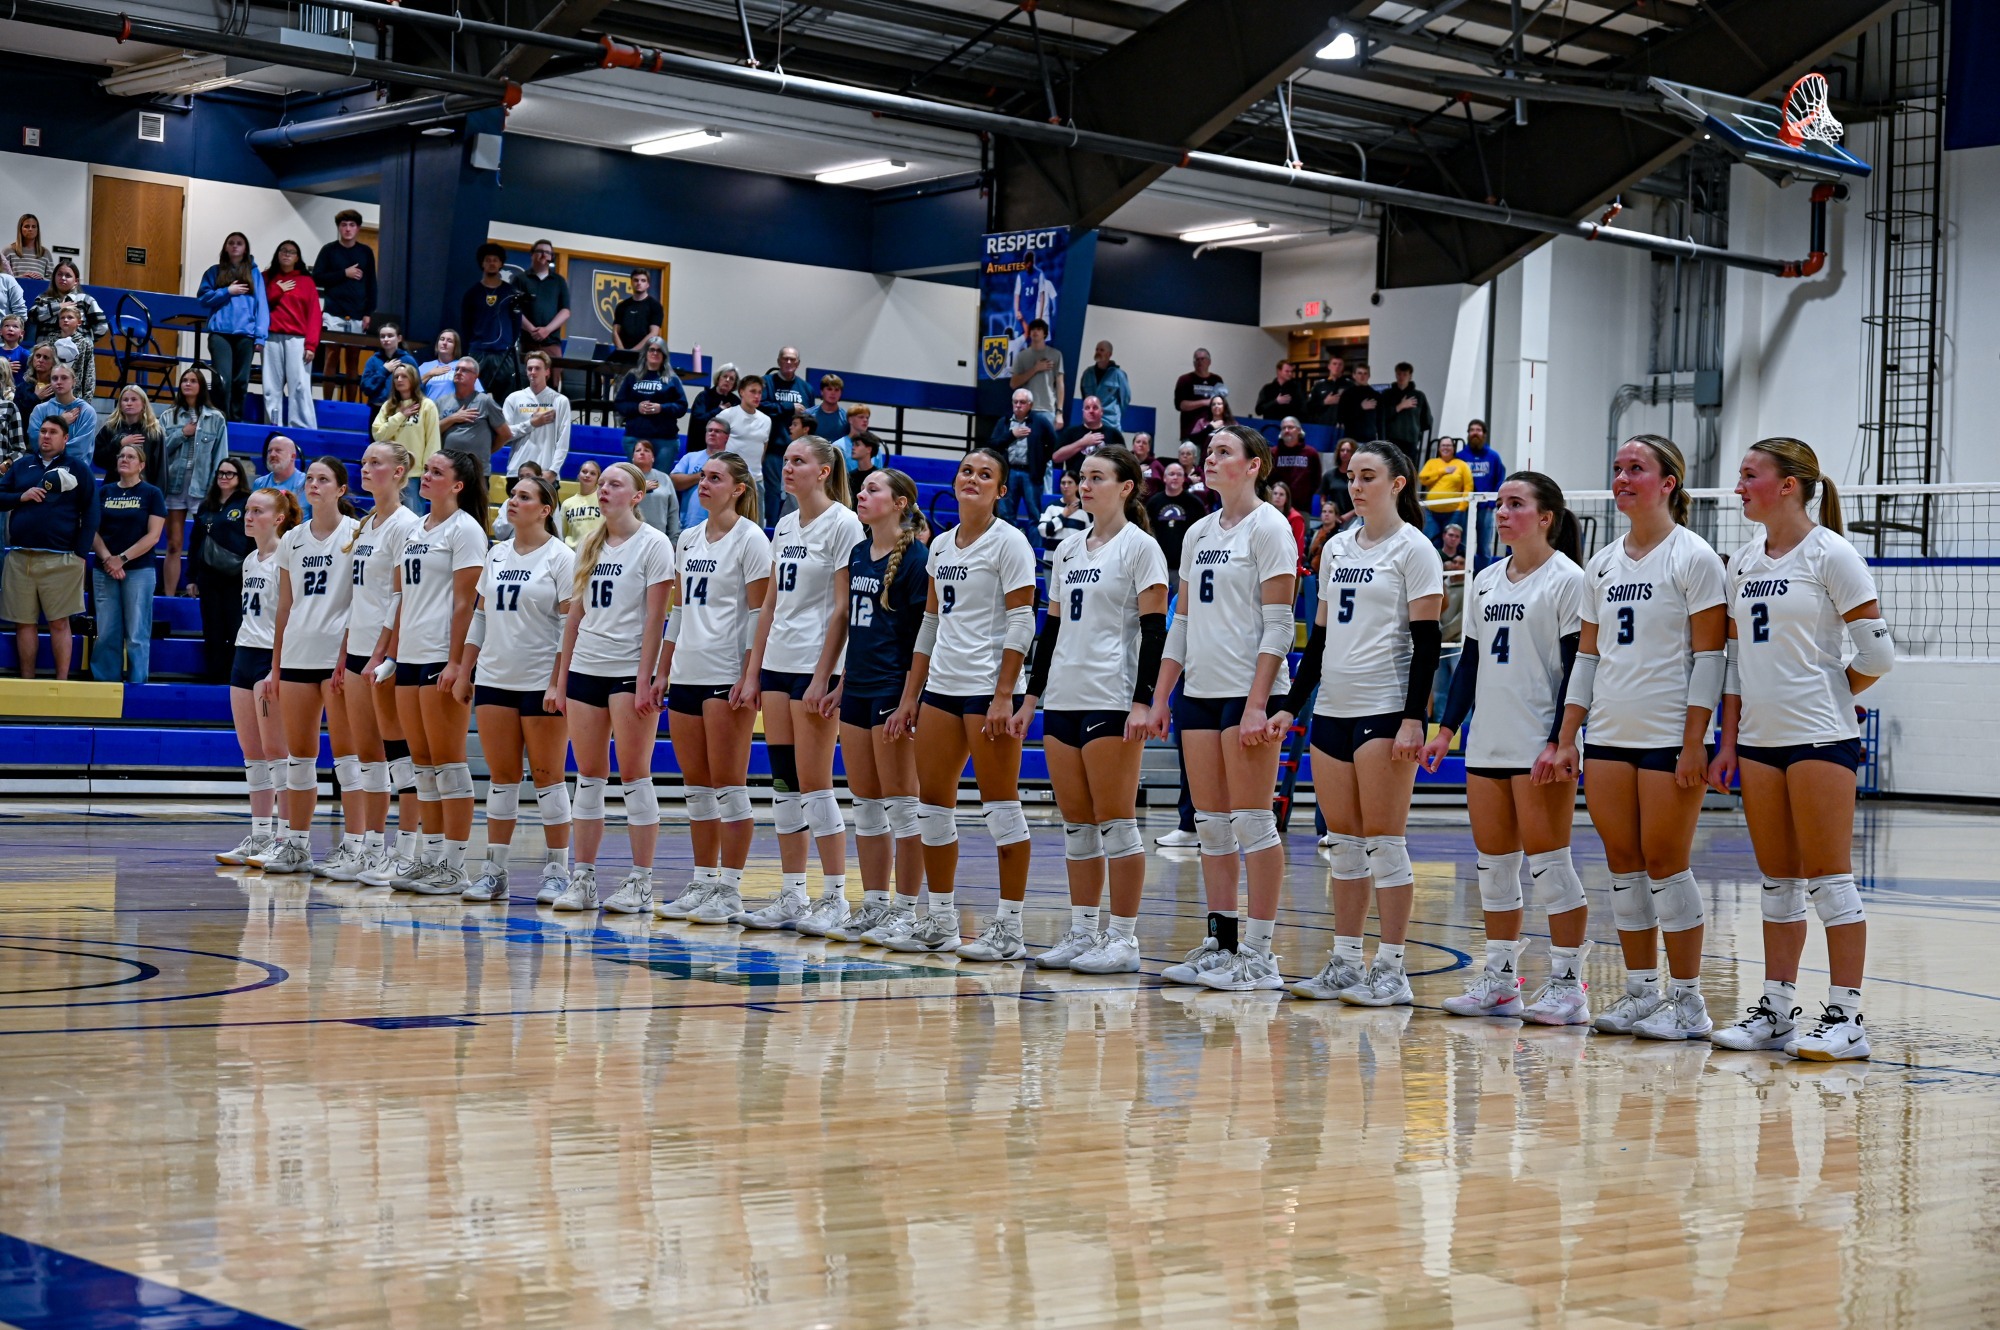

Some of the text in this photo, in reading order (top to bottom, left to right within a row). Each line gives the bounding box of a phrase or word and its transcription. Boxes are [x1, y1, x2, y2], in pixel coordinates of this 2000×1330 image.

[986, 231, 1056, 253] RESPECT
[986, 261, 1026, 274] ATHLETES
[1025, 286, 1035, 297] 24
[633, 382, 663, 391] SAINTS
[775, 392, 803, 403] SAINTS
[1277, 456, 1308, 467] AUGSBURG
[565, 506, 601, 521] SAINTS
[406, 543, 429, 554] SAINTS
[781, 546, 807, 559] SAINTS
[1196, 549, 1231, 565] SAINTS
[302, 554, 333, 568] SAINTS
[591, 563, 622, 576] SAINTS
[685, 559, 717, 573] SAINTS
[353, 560, 364, 585] 21
[405, 558, 421, 585] 18
[497, 570, 531, 581] SAINTS
[778, 563, 797, 591] 13
[936, 565, 968, 581] SAINTS
[1065, 569, 1101, 584] SAINTS
[1332, 568, 1374, 584] SAINTS
[244, 577, 265, 589] SAINTS
[304, 570, 327, 596] 22
[685, 577, 707, 605] 14
[851, 576, 880, 594] SAINTS
[1200, 569, 1214, 603] 6
[1607, 582, 1653, 602] SAINTS
[1741, 579, 1790, 599] SAINTS
[496, 585, 520, 611] 17
[591, 580, 613, 608] 16
[942, 585, 955, 614] 9
[242, 593, 261, 617] 24
[850, 595, 873, 627] 12
[1070, 588, 1084, 621] 8
[1337, 588, 1356, 624] 5
[1484, 604, 1525, 622] SAINTS
[1616, 607, 1635, 645] 3
[1750, 602, 1770, 643] 2
[1490, 626, 1510, 664] 4
